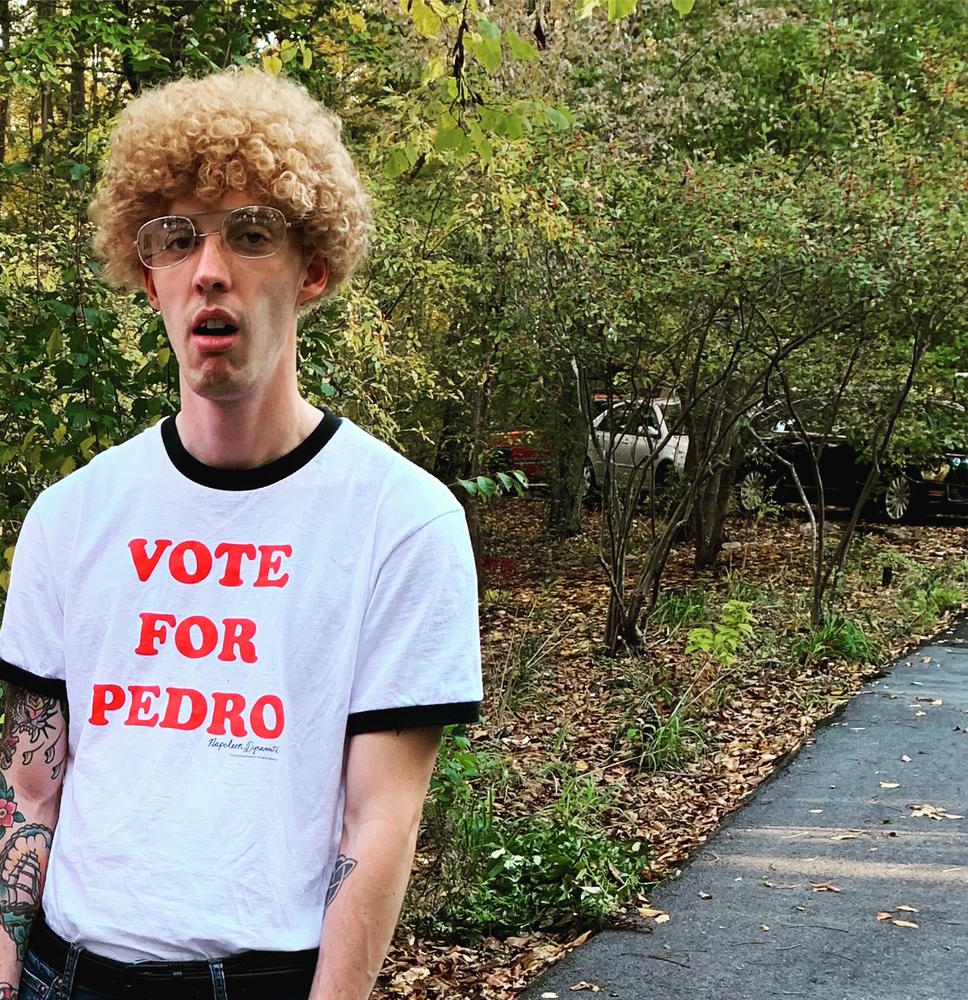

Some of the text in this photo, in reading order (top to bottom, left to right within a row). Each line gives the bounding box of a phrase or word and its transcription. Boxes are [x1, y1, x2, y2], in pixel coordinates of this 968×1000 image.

[128, 538, 292, 588] VOTE
[135, 612, 258, 664] FOR
[88, 684, 285, 739] PEDRO
